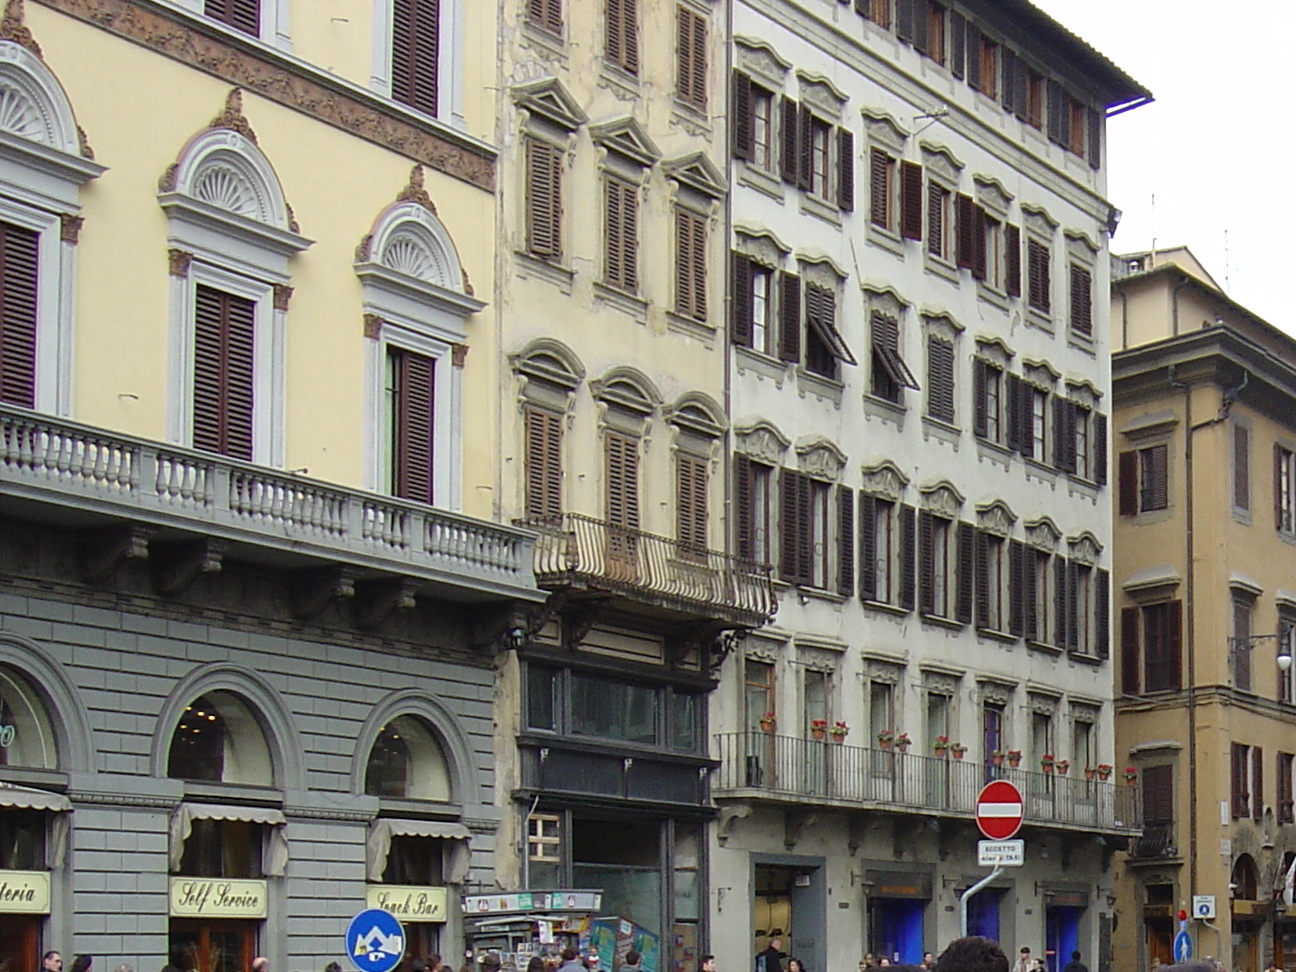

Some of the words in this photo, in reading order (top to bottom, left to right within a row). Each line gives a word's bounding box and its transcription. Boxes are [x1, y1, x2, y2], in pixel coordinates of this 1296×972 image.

[179, 881, 214, 912] Self
[213, 883, 259, 908] Service
[412, 892, 439, 915] Bar
